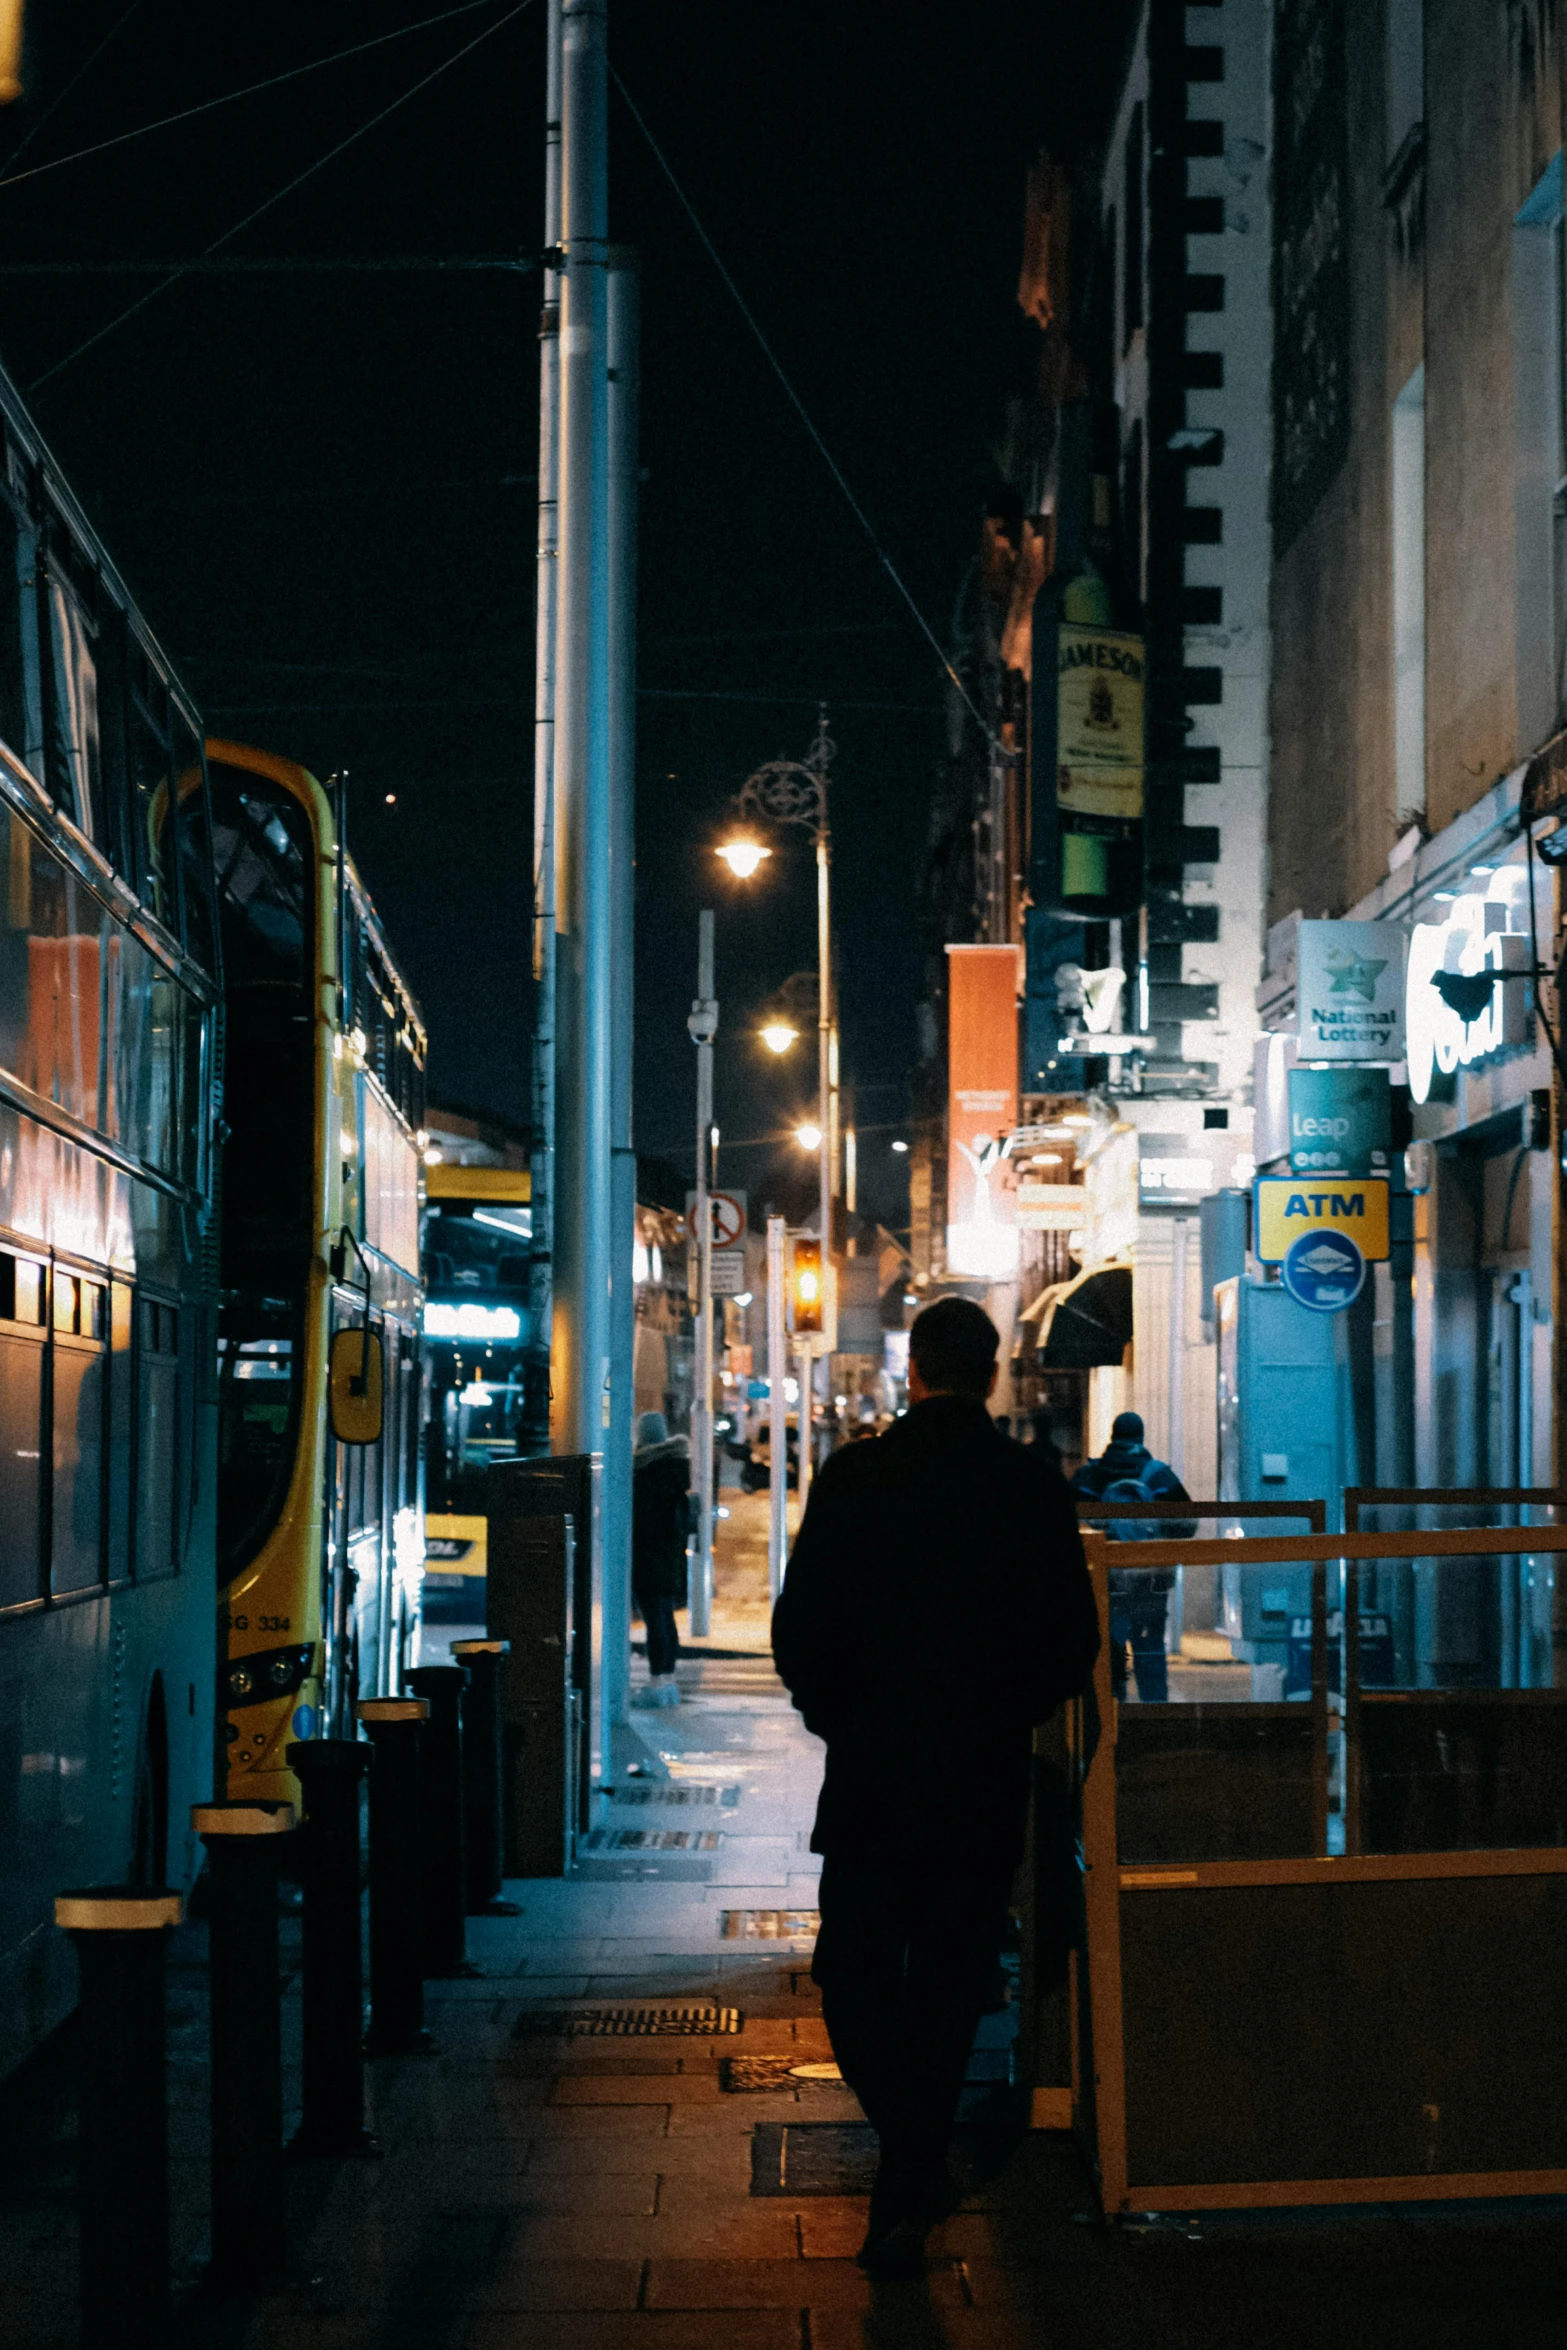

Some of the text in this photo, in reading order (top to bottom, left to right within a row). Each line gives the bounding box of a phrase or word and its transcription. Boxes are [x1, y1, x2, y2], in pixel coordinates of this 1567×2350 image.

[1311, 1008, 1396, 1025] National
[1318, 1025, 1391, 1046] Lottery
[1284, 1193, 1365, 1217] ATM
[258, 1615, 290, 1632] 334
